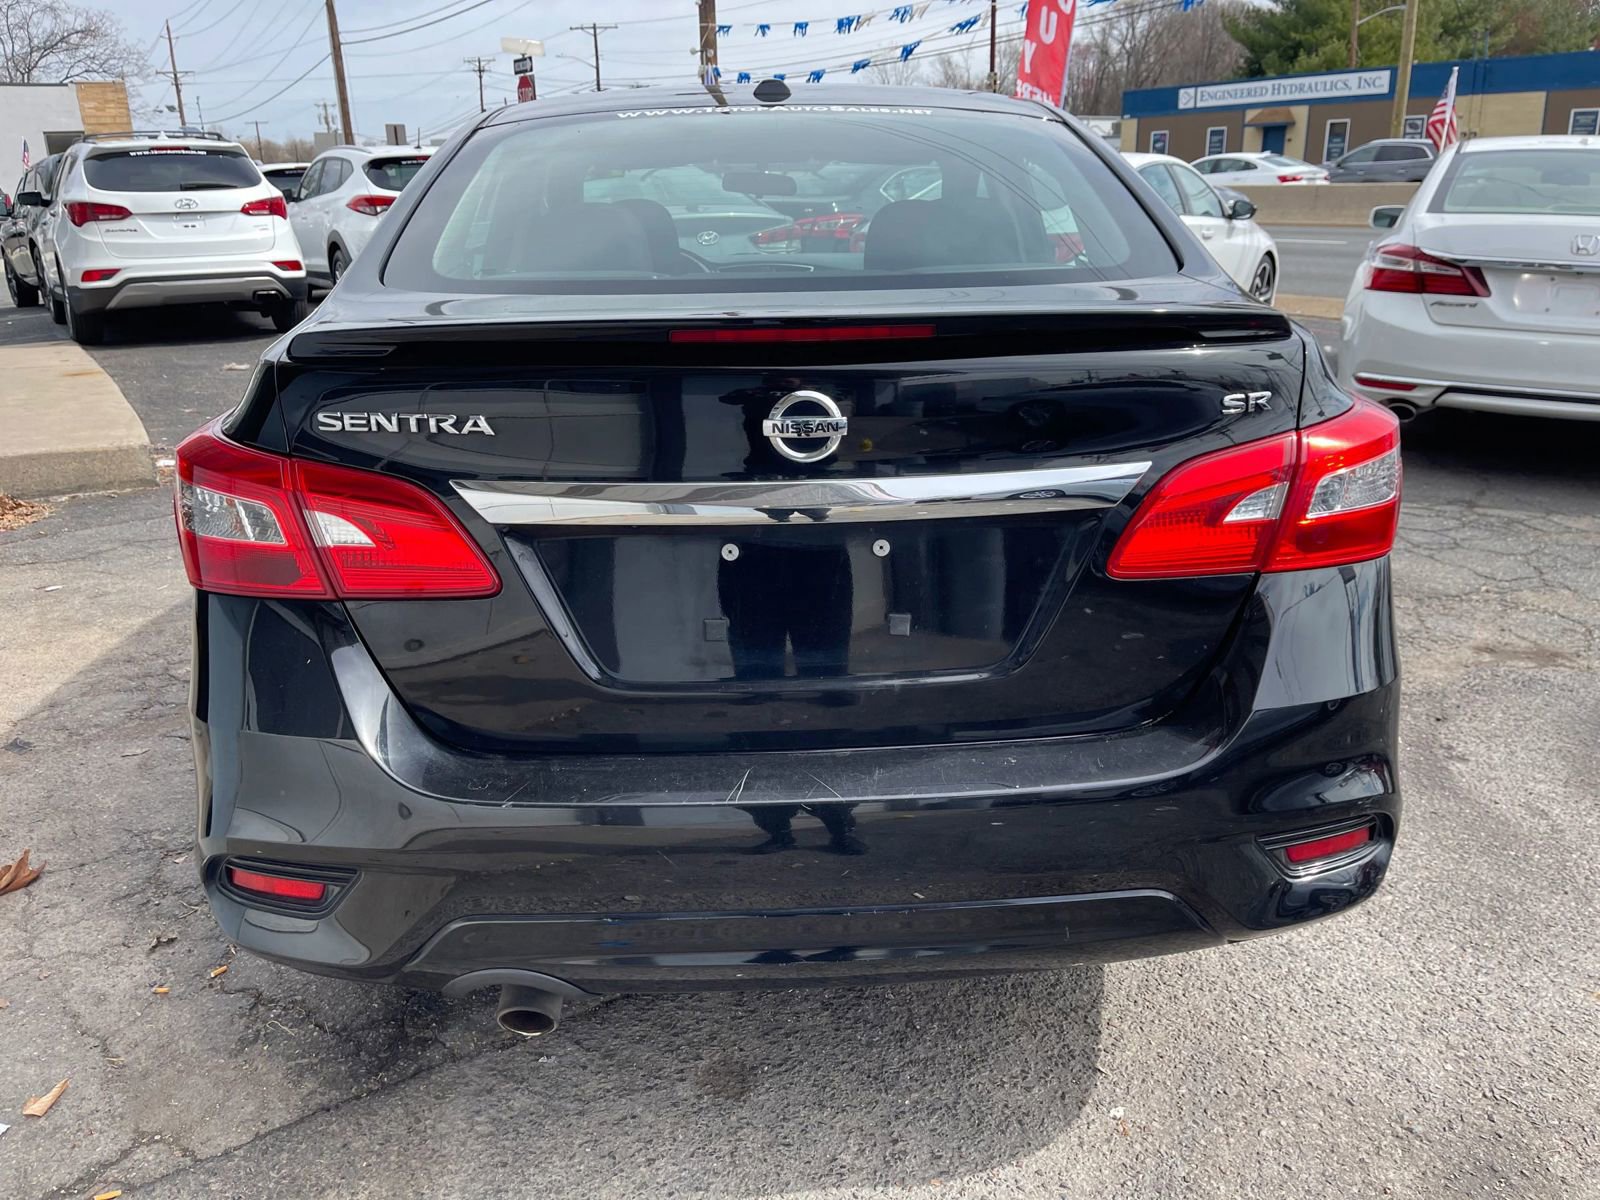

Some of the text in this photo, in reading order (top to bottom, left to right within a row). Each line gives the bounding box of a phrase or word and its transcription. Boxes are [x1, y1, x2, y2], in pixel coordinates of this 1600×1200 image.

[1200, 75, 1384, 101] ENGINEERED HYDRAULICS, INC.
[1222, 391, 1272, 414] SR
[317, 412, 495, 436] SENTRA
[772, 422, 839, 434] NISSAN
